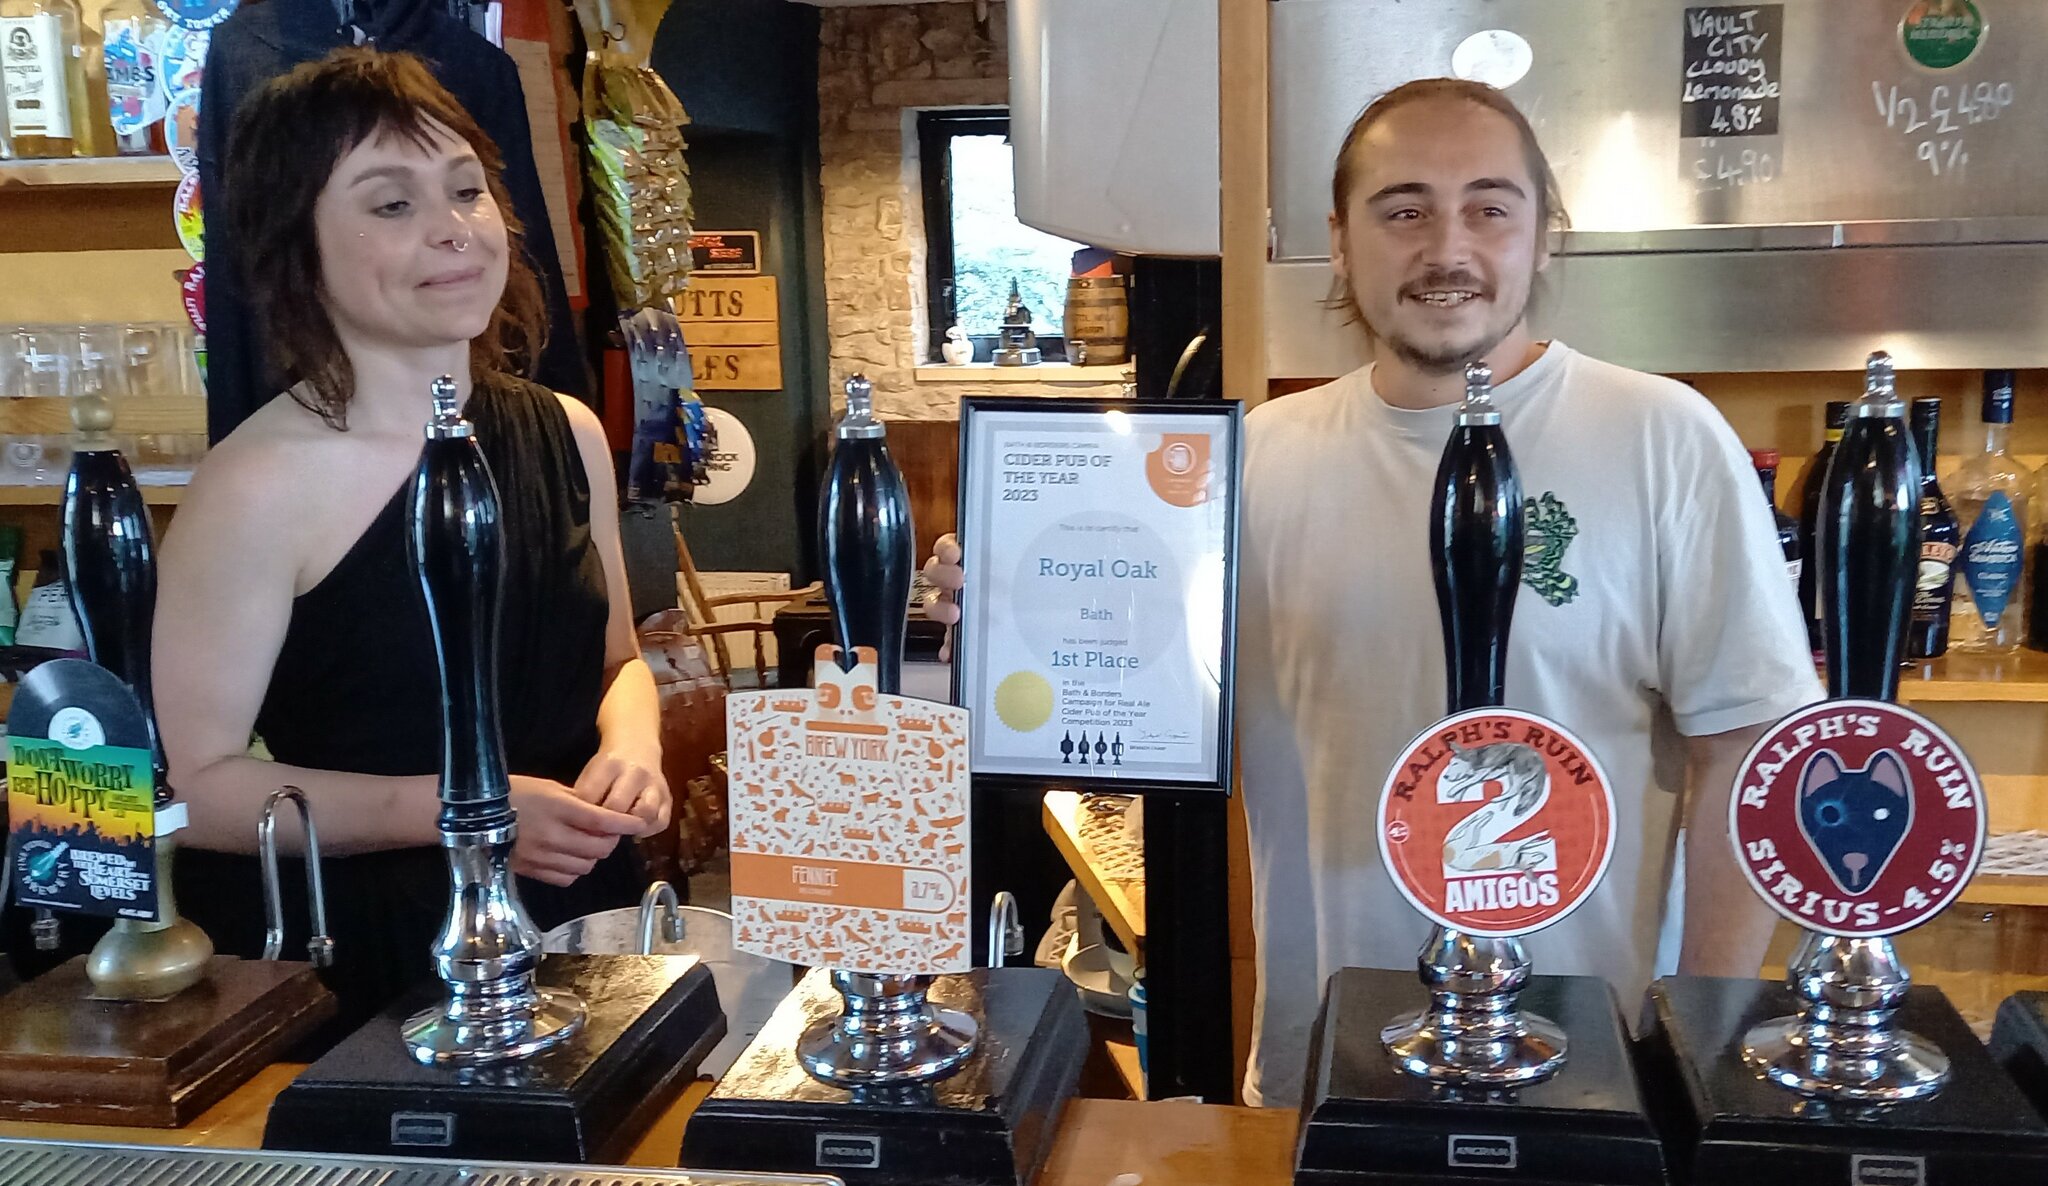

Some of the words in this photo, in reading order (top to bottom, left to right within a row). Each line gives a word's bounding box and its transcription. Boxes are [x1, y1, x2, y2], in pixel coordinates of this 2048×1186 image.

[1688, 10, 1760, 38] VAULT
[1707, 33, 1769, 57] CITY
[1710, 103, 1762, 133] 4.8%
[1917, 139, 1969, 176] 9%
[1003, 453, 1052, 466] CIDER
[1055, 454, 1088, 467] PUB
[1090, 455, 1112, 467] OF
[1003, 471, 1036, 483] THE
[1039, 472, 1079, 484] YEAR
[1002, 489, 1039, 501] 2023
[1039, 558, 1104, 581] Royal
[1111, 559, 1158, 579] Oak
[1080, 608, 1113, 620] Bath
[1051, 650, 1079, 667] 1st
[1085, 651, 1139, 669] Place
[1062, 698, 1102, 707] Campaign
[1082, 689, 1089, 697] &
[1061, 717, 1111, 726] Competition
[806, 735, 849, 758] BREW
[851, 738, 889, 761] YORK
[1394, 722, 1512, 802] RALPH'S
[1525, 726, 1594, 786] RUIN
[1741, 714, 1881, 809] RALPH'S
[1900, 729, 1973, 810] RUIN
[60, 757, 136, 791] WORRY
[35, 770, 110, 818] HOPPY
[79, 870, 152, 891] SOMERSET
[90, 885, 137, 900] LEVELS
[1445, 874, 1560, 913] AMIGOS
